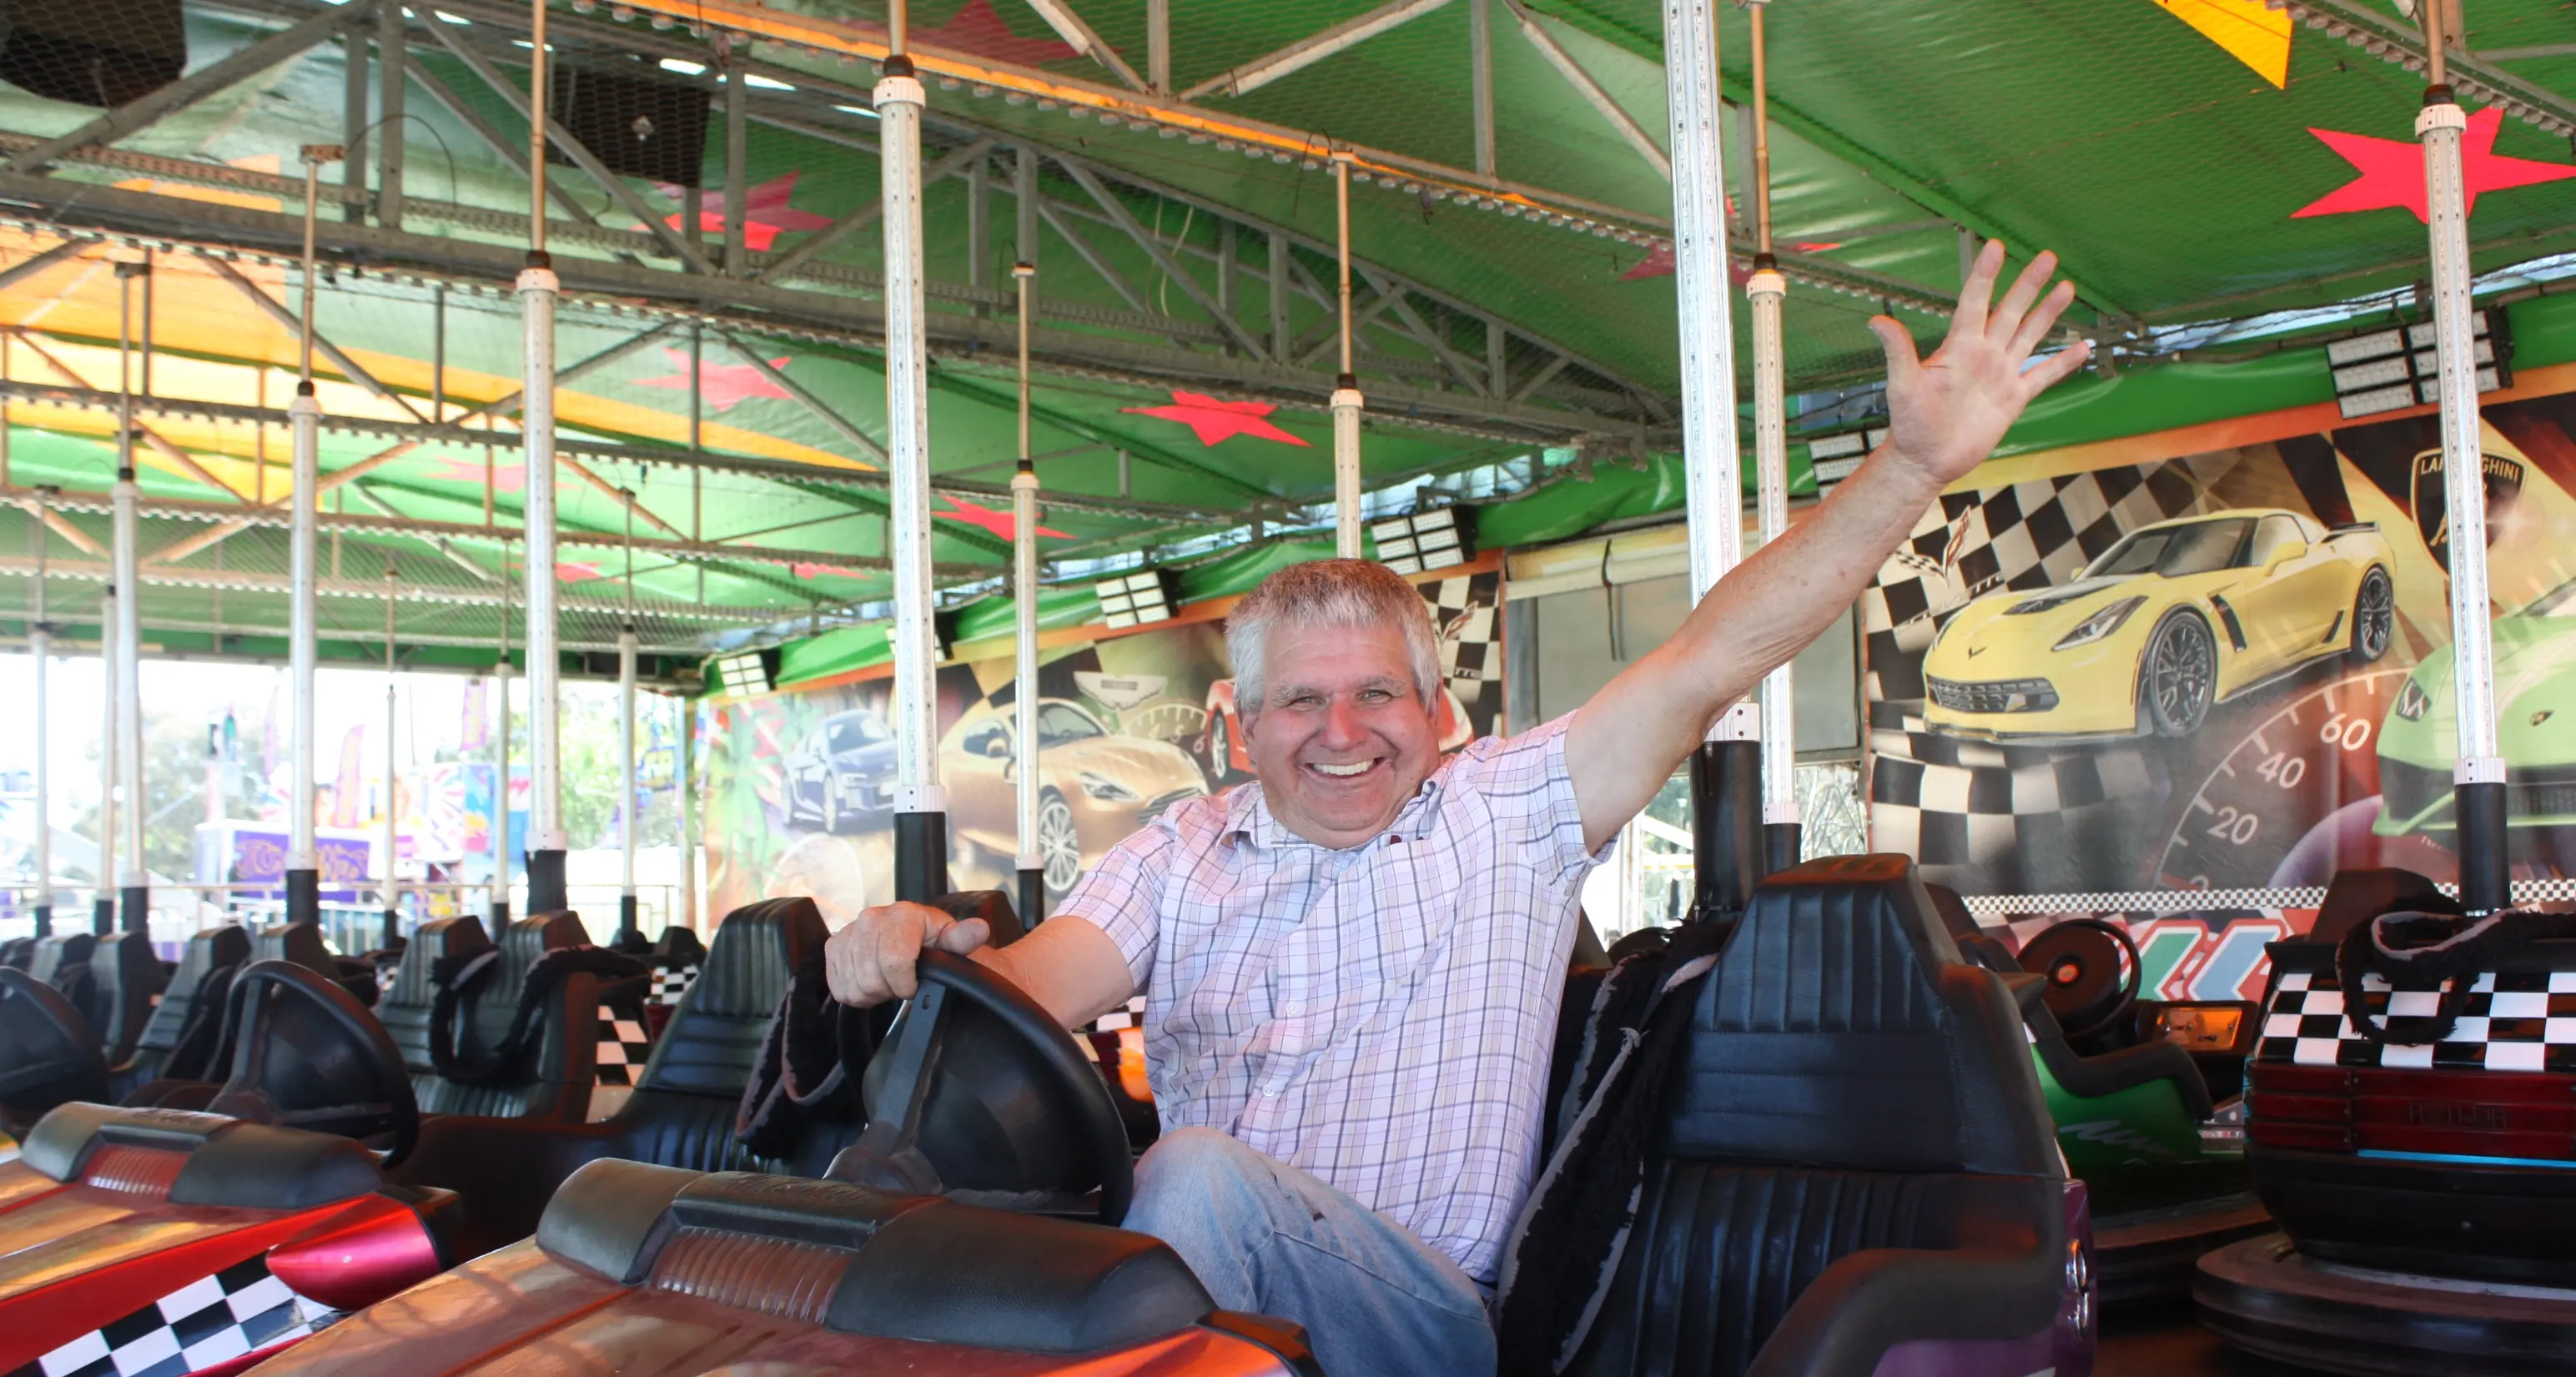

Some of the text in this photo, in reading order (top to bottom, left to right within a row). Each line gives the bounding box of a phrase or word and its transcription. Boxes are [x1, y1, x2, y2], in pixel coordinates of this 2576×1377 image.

[2420, 456, 2519, 483] LAGHINI
[1193, 735, 1206, 754] 6
[2320, 713, 2372, 751] 60
[2256, 752, 2306, 789] 40
[2206, 806, 2259, 846] 20
